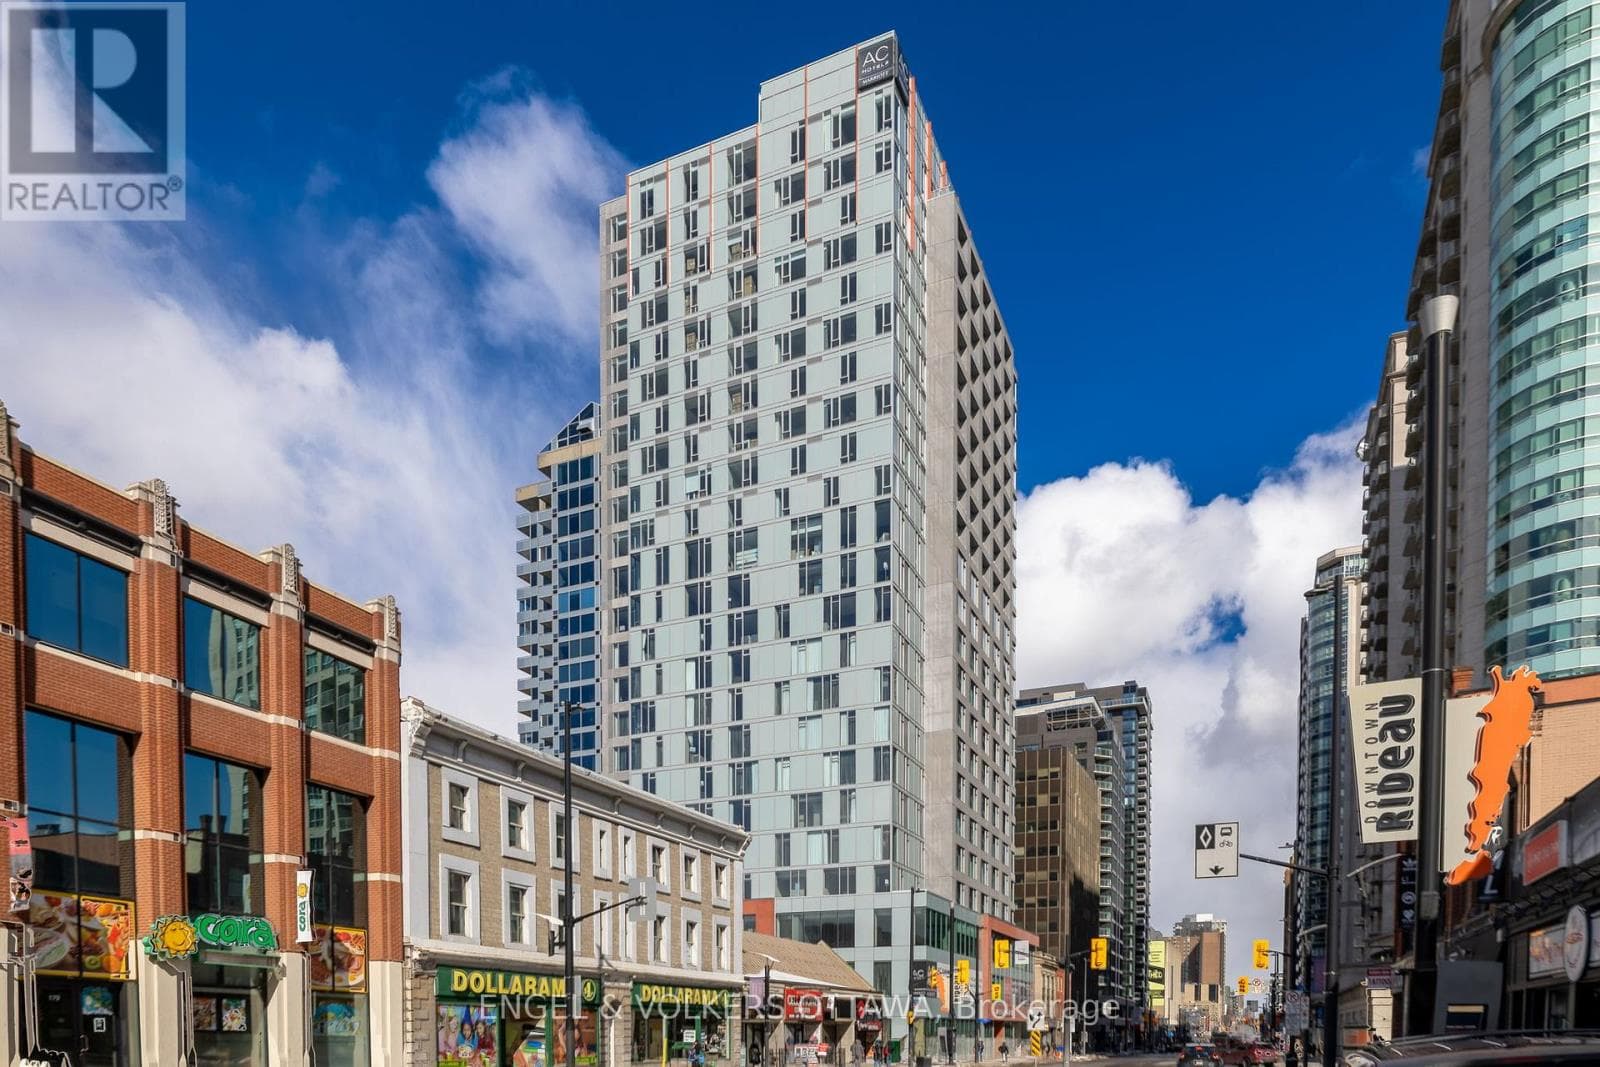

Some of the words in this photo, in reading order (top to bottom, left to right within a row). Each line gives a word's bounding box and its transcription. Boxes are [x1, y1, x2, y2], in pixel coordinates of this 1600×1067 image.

[862, 45, 889, 67] AC
[1364, 702, 1379, 824] DOWNTOWN
[199, 913, 275, 949] cora
[299, 900, 307, 933] cora
[452, 968, 570, 999] DOLLARAM
[641, 984, 719, 1006] DOLLARAMA
